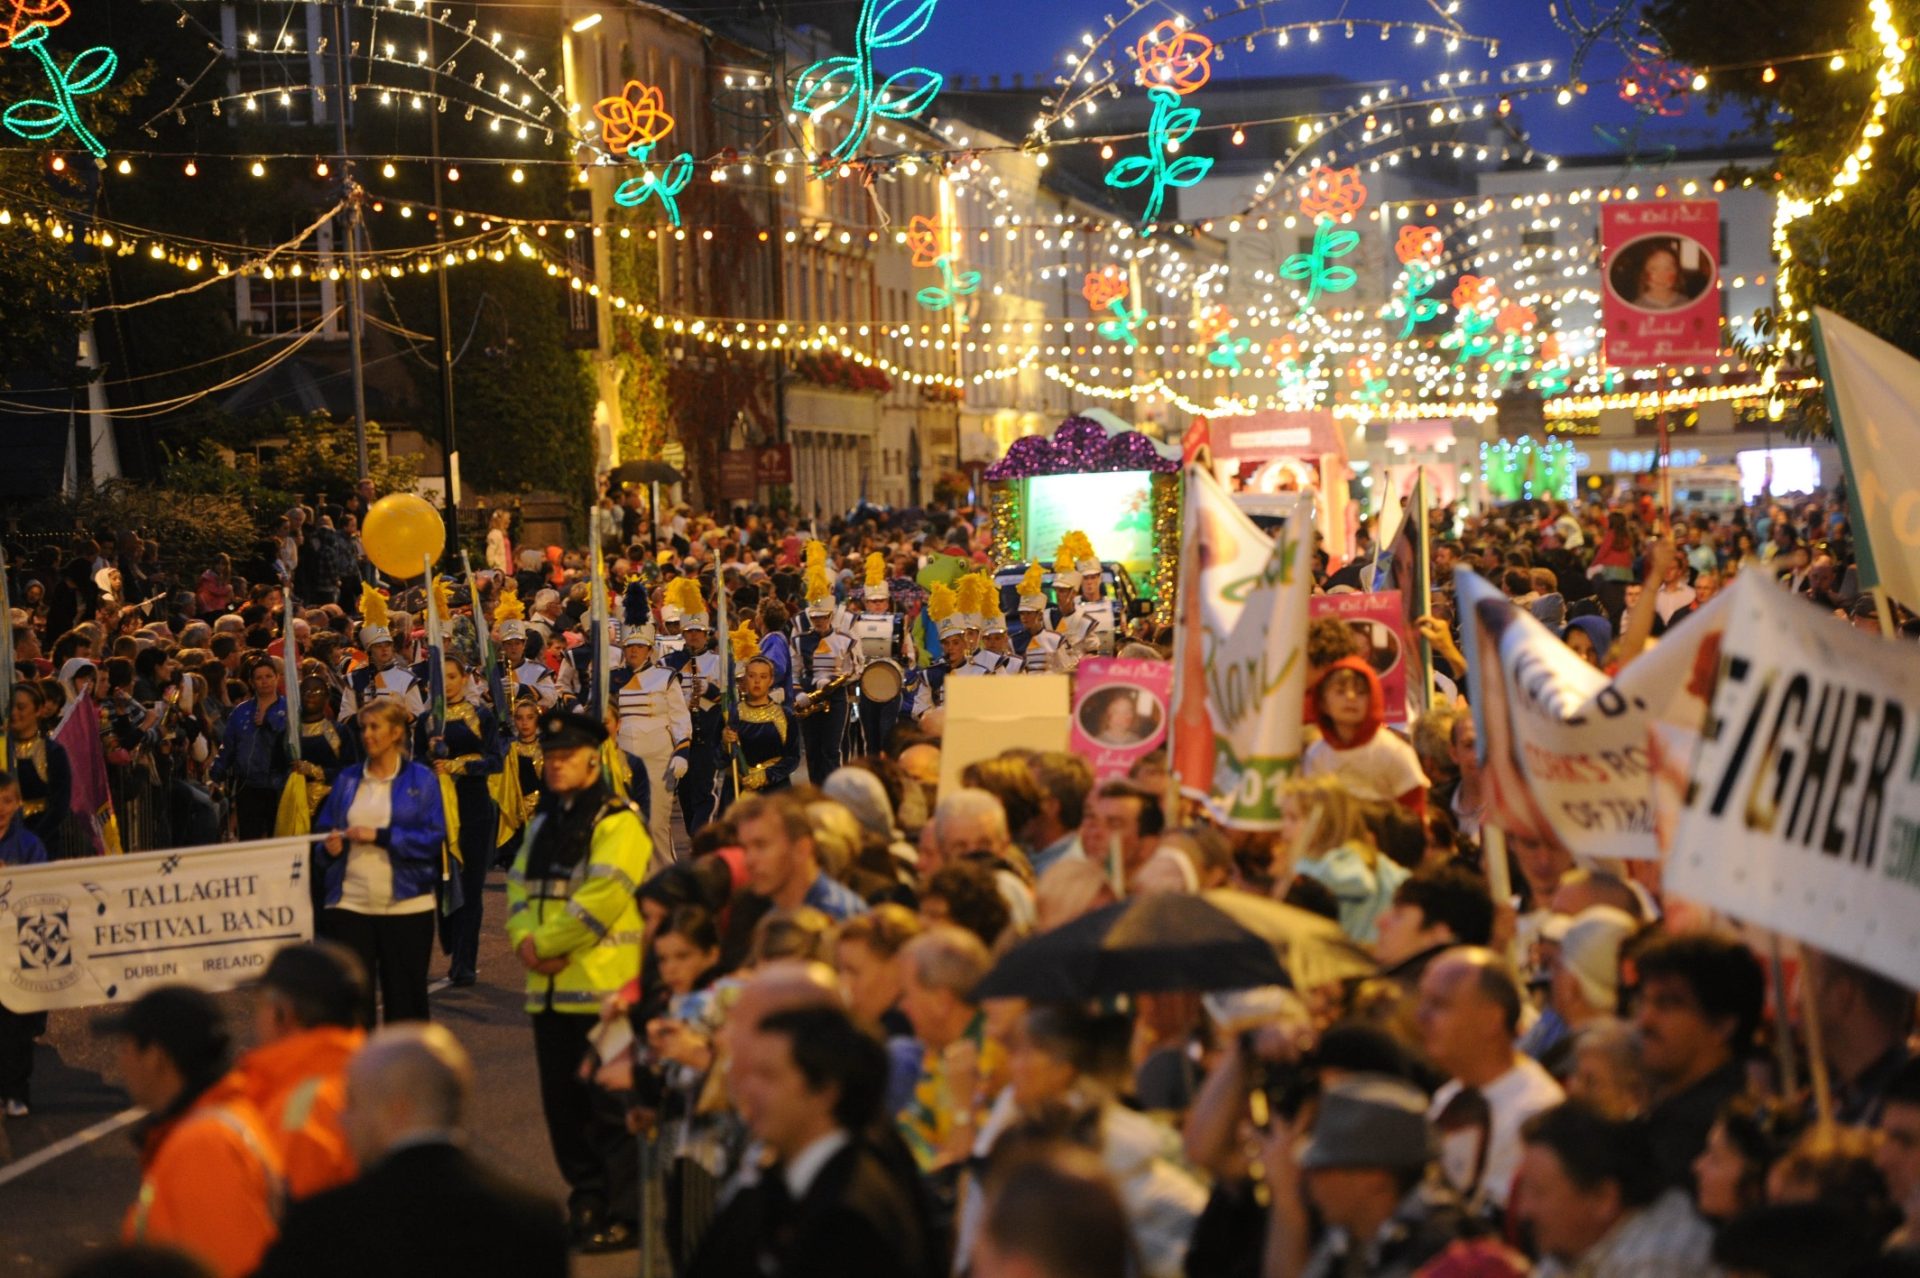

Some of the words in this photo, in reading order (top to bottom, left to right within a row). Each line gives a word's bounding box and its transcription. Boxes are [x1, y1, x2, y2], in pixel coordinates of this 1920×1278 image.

[124, 875, 258, 908] TALLAGHT
[94, 915, 212, 946] FESTIVAL
[221, 906, 294, 933] BAND
[124, 963, 177, 980] DUBLIN
[202, 954, 264, 972] IRELAND
